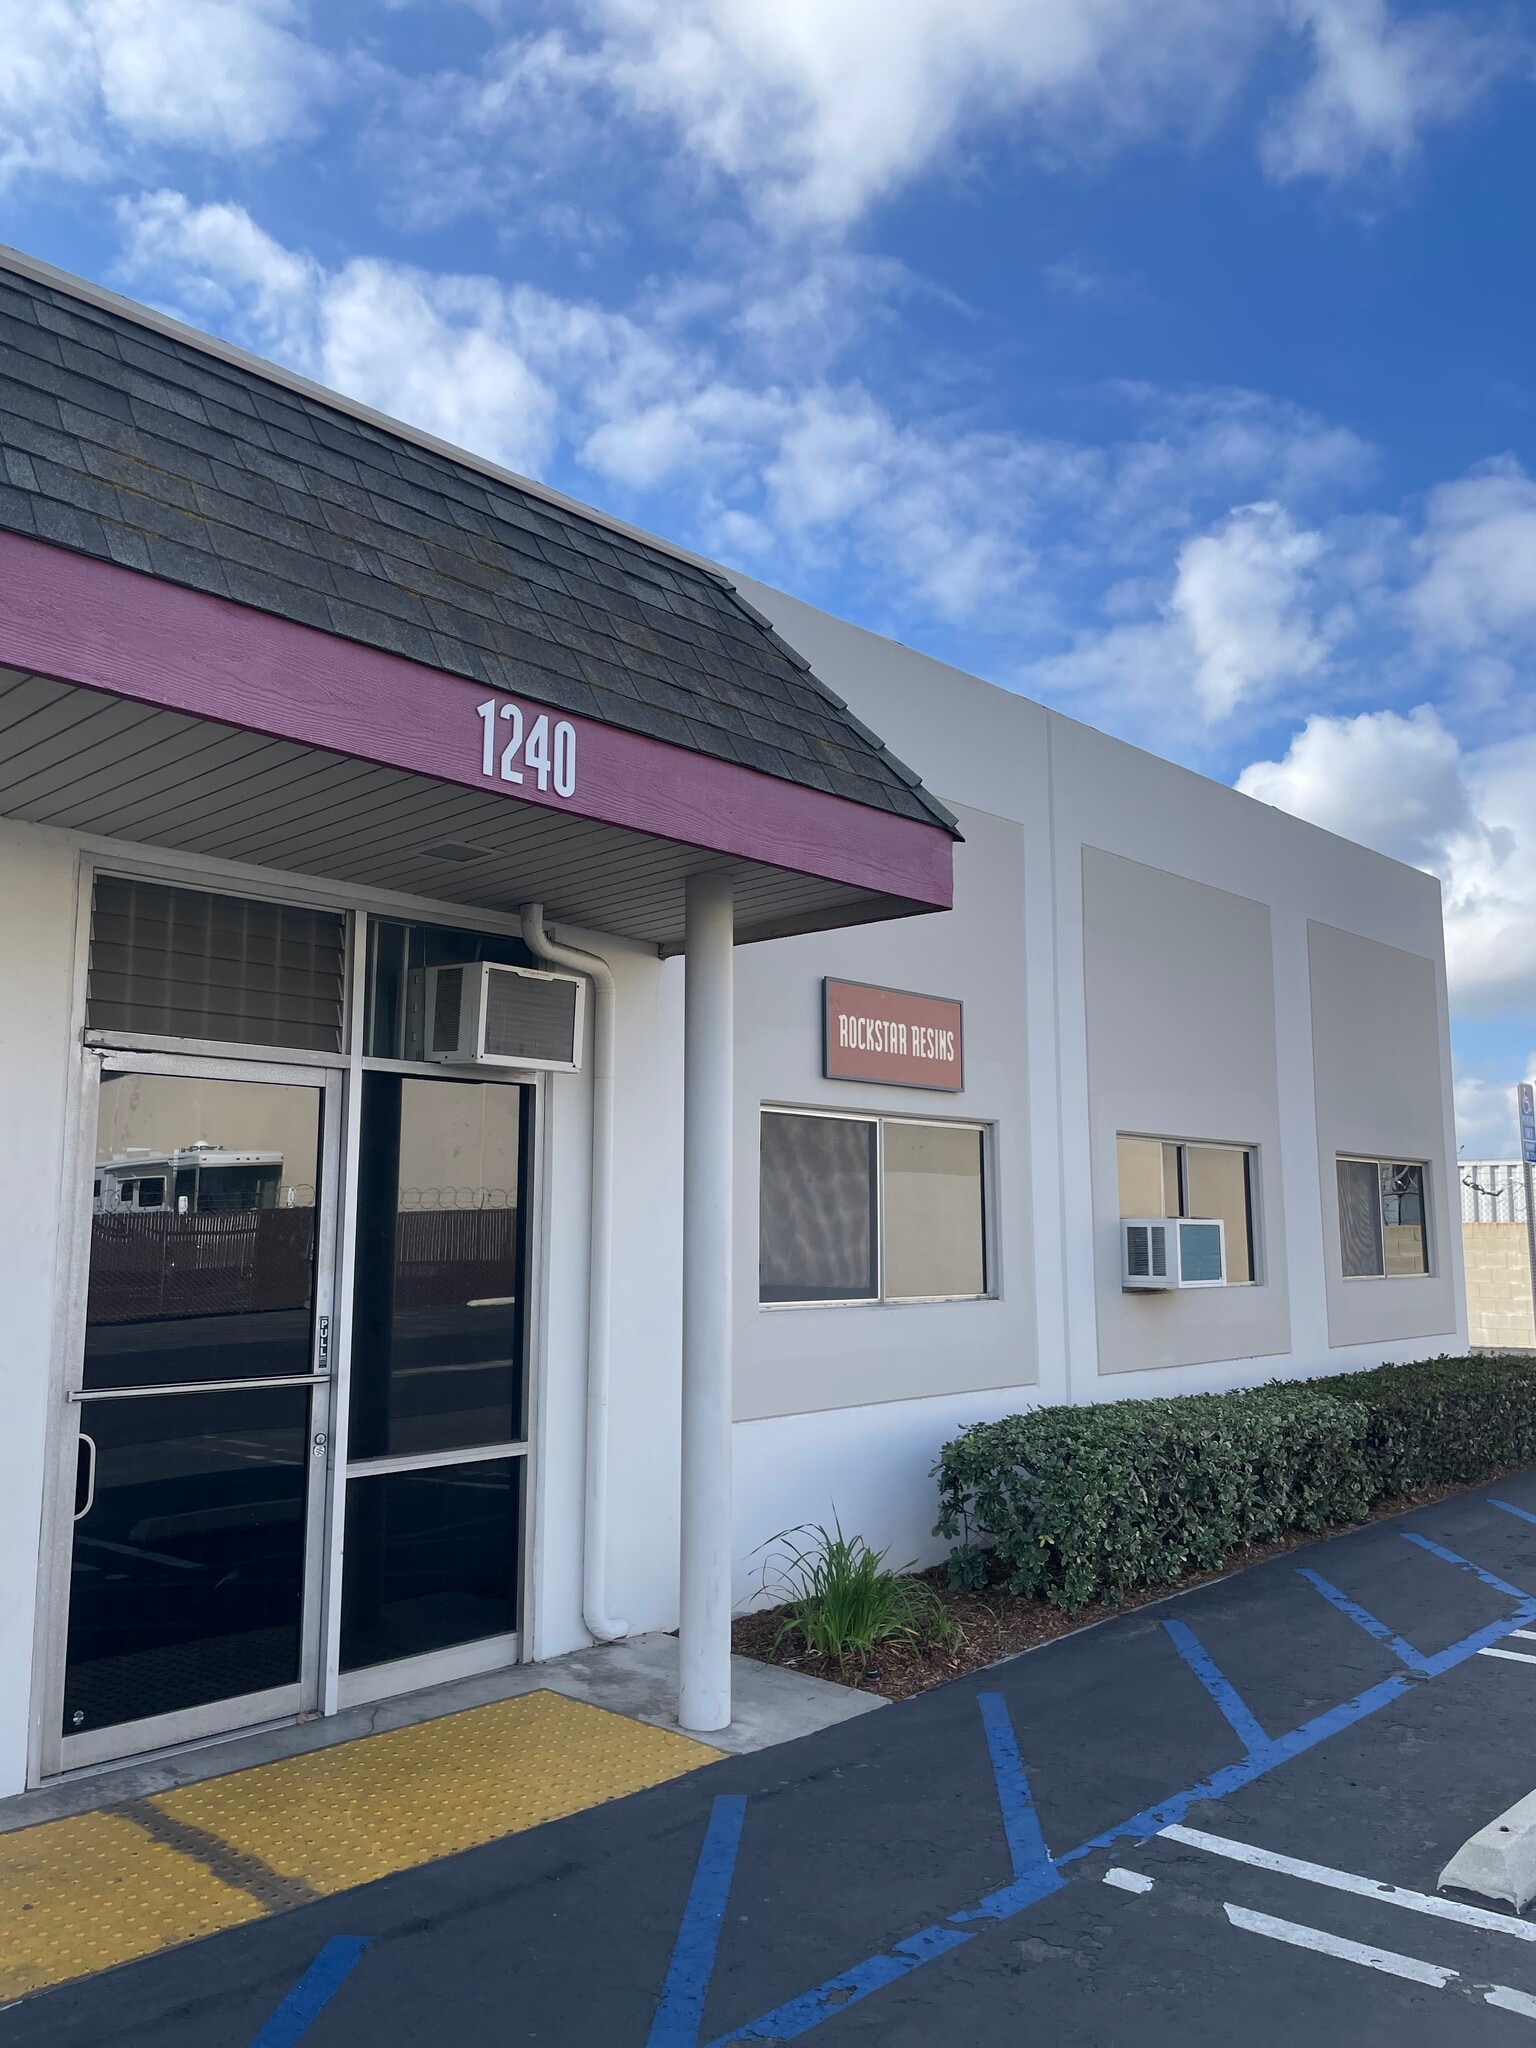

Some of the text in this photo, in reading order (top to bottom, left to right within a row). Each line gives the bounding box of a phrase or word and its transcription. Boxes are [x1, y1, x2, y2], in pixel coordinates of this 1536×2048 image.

[476, 699, 576, 798] 1240
[838, 1014, 954, 1062] ROCKSTAR RESINS
[320, 1319, 328, 1356] PULL
